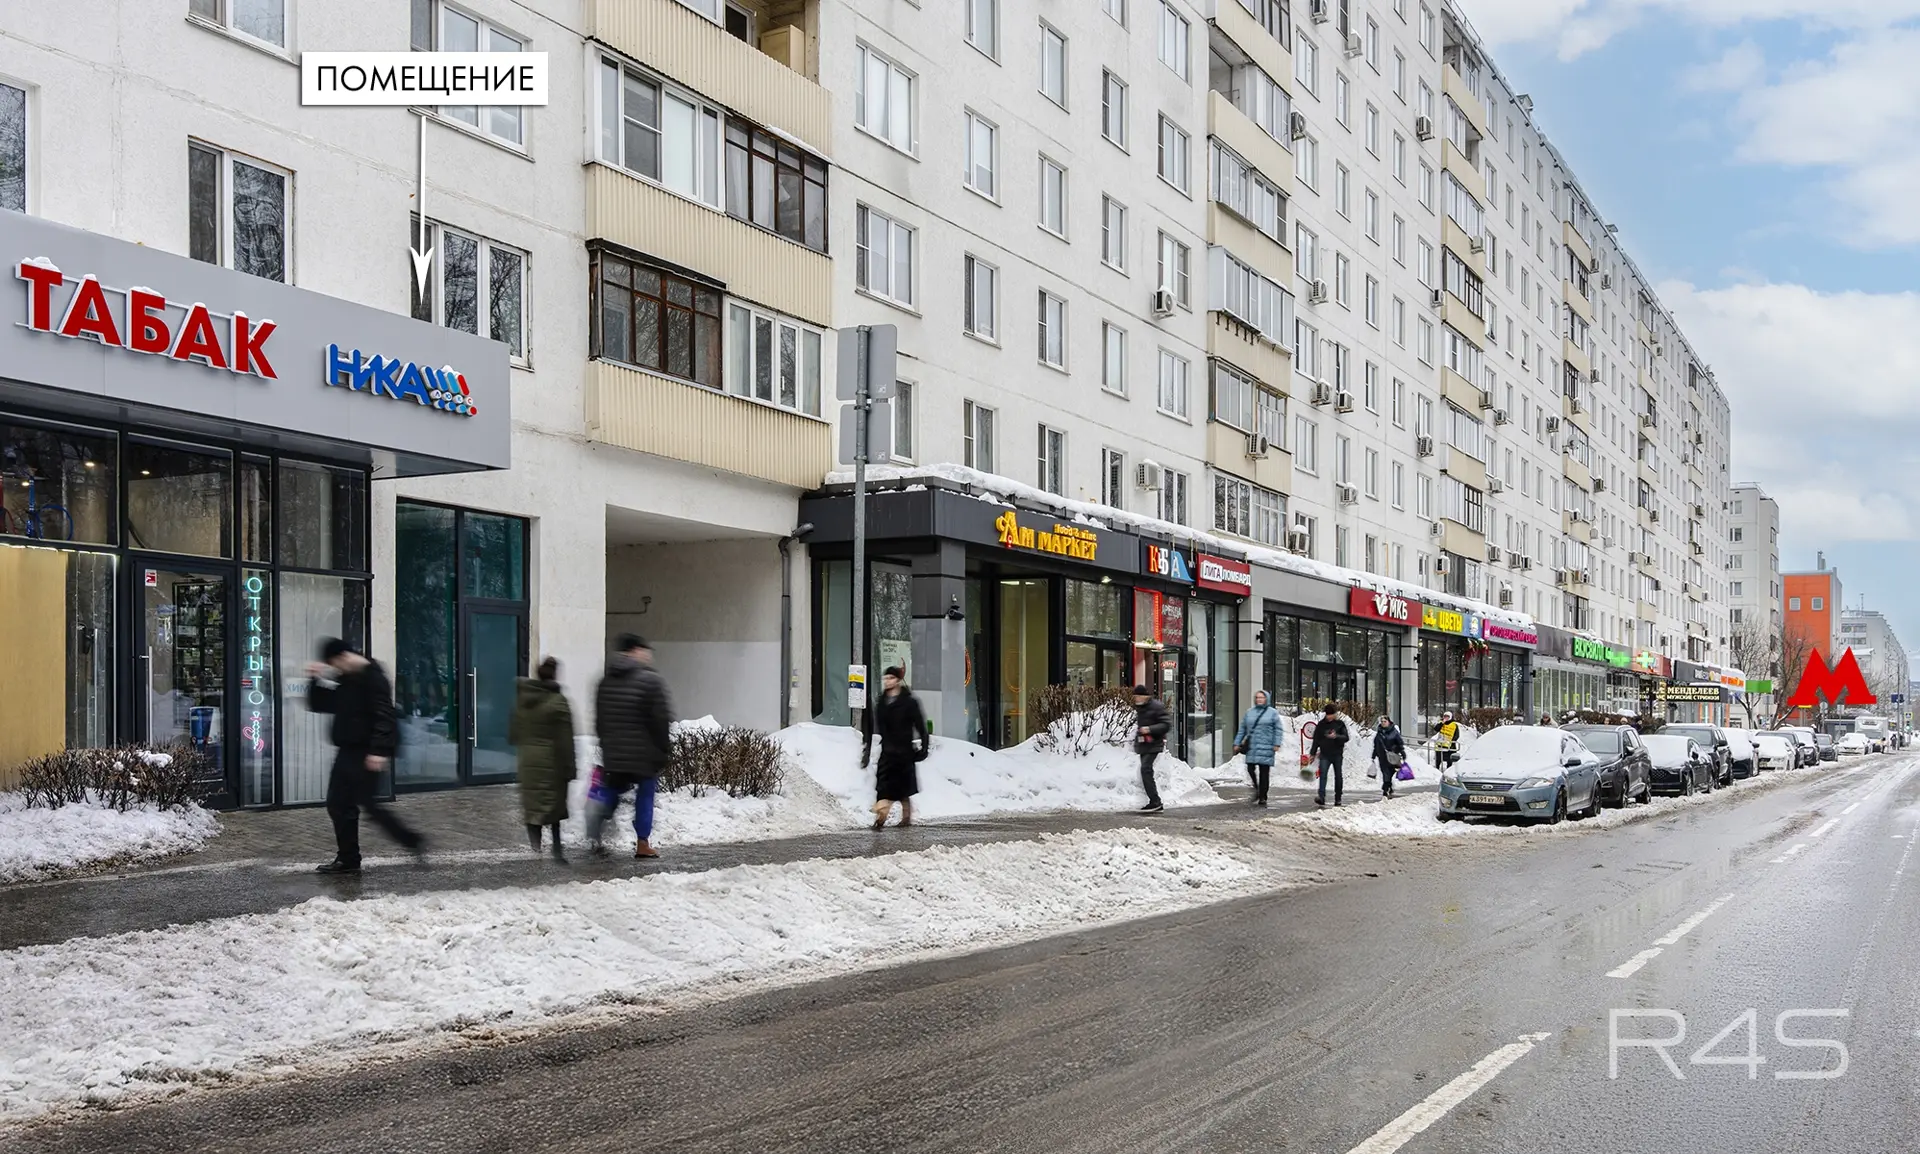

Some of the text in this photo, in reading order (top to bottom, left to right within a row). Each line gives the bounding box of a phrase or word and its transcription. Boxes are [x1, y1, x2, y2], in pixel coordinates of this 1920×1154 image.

[16, 262, 279, 379] ТАБАК
[1037, 531, 1097, 560] МАРКЕТ
[1204, 562, 1221, 579] ЛИГА
[1222, 568, 1251, 586] ЛОМБАРД
[1389, 597, 1408, 620] МКБ
[1439, 611, 1463, 633] ЦВЕТЫ
[246, 577, 265, 705] ОТКРЫТО
[1667, 686, 1719, 695] МЕНДЕЛЕЕВ
